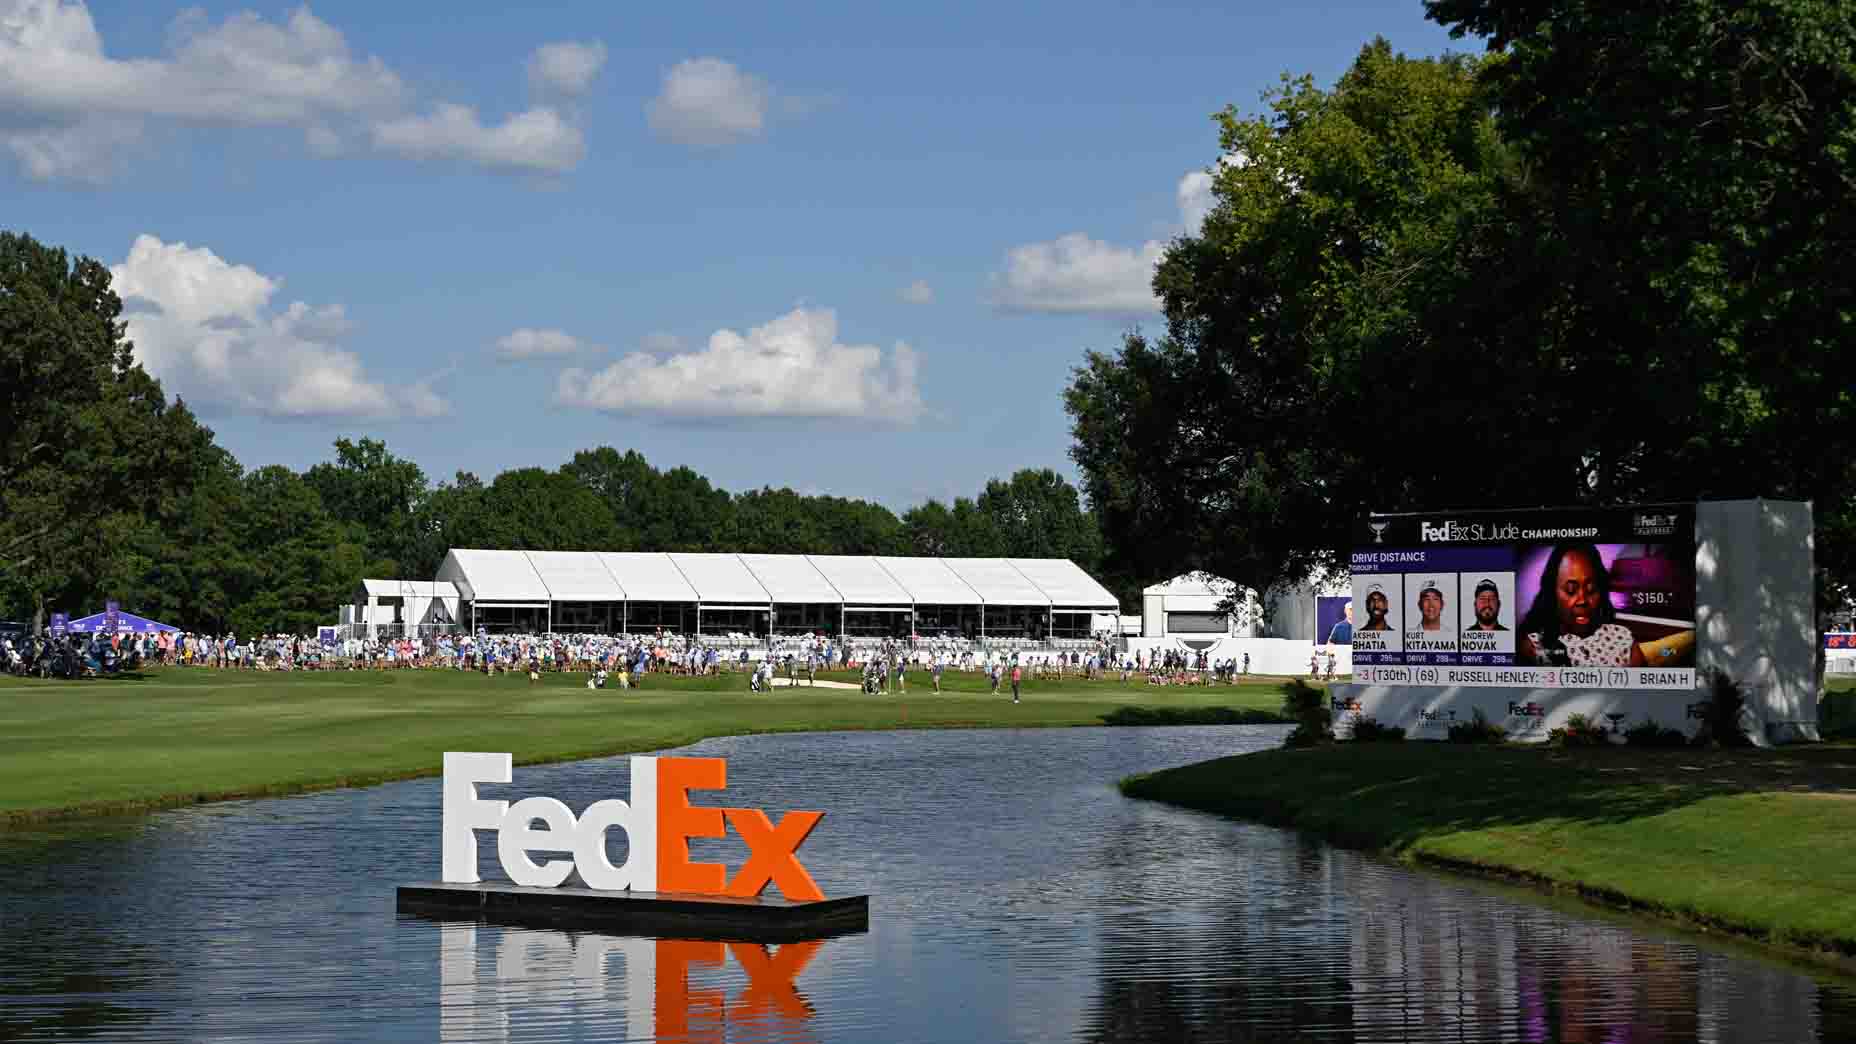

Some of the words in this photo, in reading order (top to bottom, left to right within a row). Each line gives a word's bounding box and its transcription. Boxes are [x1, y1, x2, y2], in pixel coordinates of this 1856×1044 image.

[1421, 521, 1470, 542] FedEx
[1487, 521, 1520, 541] Jude
[1352, 553, 1378, 563] DRIVE
[1379, 552, 1425, 562] DISTANCE
[1352, 632, 1381, 640] AKSHAY
[1406, 632, 1425, 640] KURT
[1462, 632, 1494, 640] ANDREW
[1352, 641, 1387, 650] BHATIA
[1406, 641, 1456, 650] KITAYAMA
[1461, 641, 1497, 651] NOVAK
[1462, 655, 1483, 663] DRIVE
[1372, 667, 1411, 683] (T30th)
[1416, 667, 1439, 683] (69)
[1449, 671, 1493, 682] RUSSELL
[1496, 671, 1538, 684] HENLEY:
[1542, 671, 1556, 683] -3
[1559, 669, 1602, 687] (T30th)
[1608, 669, 1629, 686] (71)
[1640, 673, 1676, 685] BRIAN
[1680, 674, 1688, 685] H
[442, 752, 826, 901] FedEx
